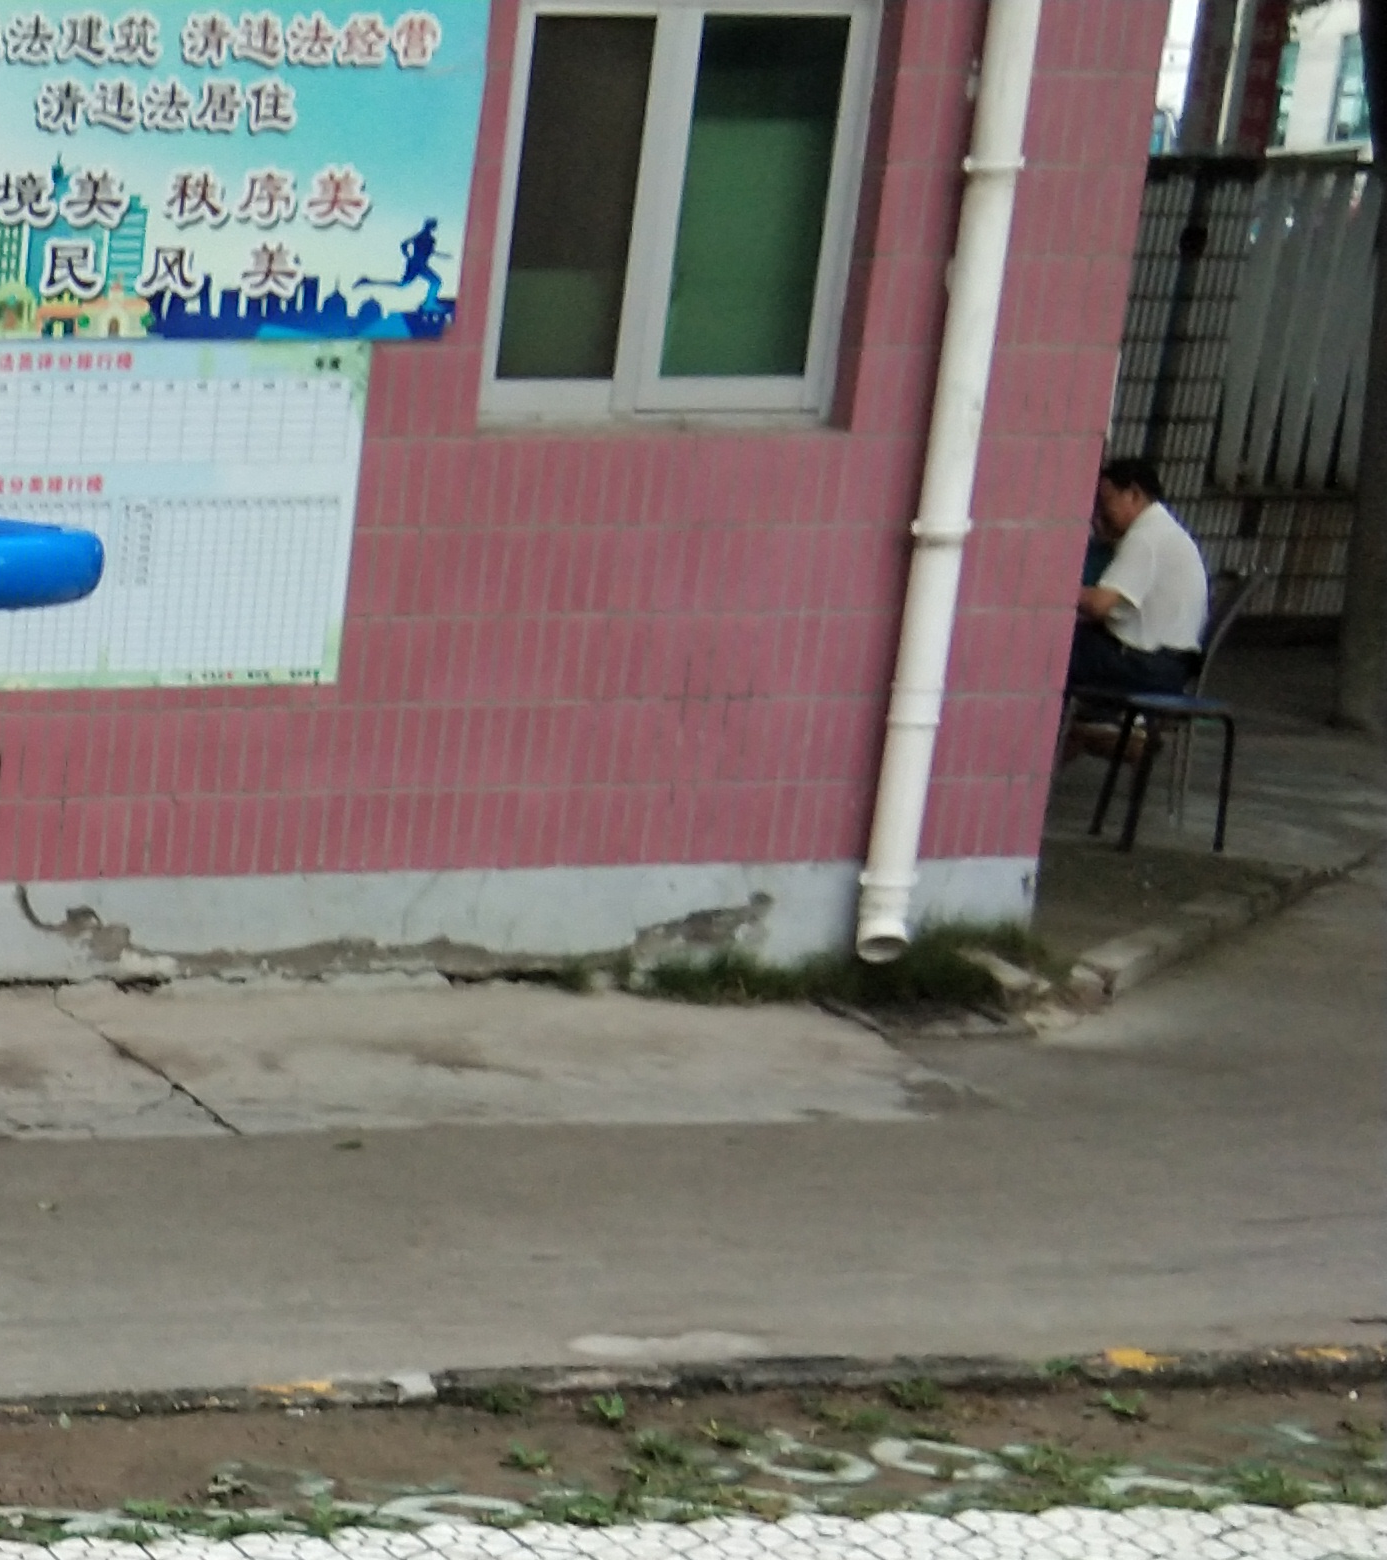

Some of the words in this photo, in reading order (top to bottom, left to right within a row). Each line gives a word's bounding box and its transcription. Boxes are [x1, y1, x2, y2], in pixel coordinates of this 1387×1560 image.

[183, 13, 439, 66] 清违法经营
[36, 81, 295, 132] 清违法居住
[164, 168, 369, 226] 秩序美
